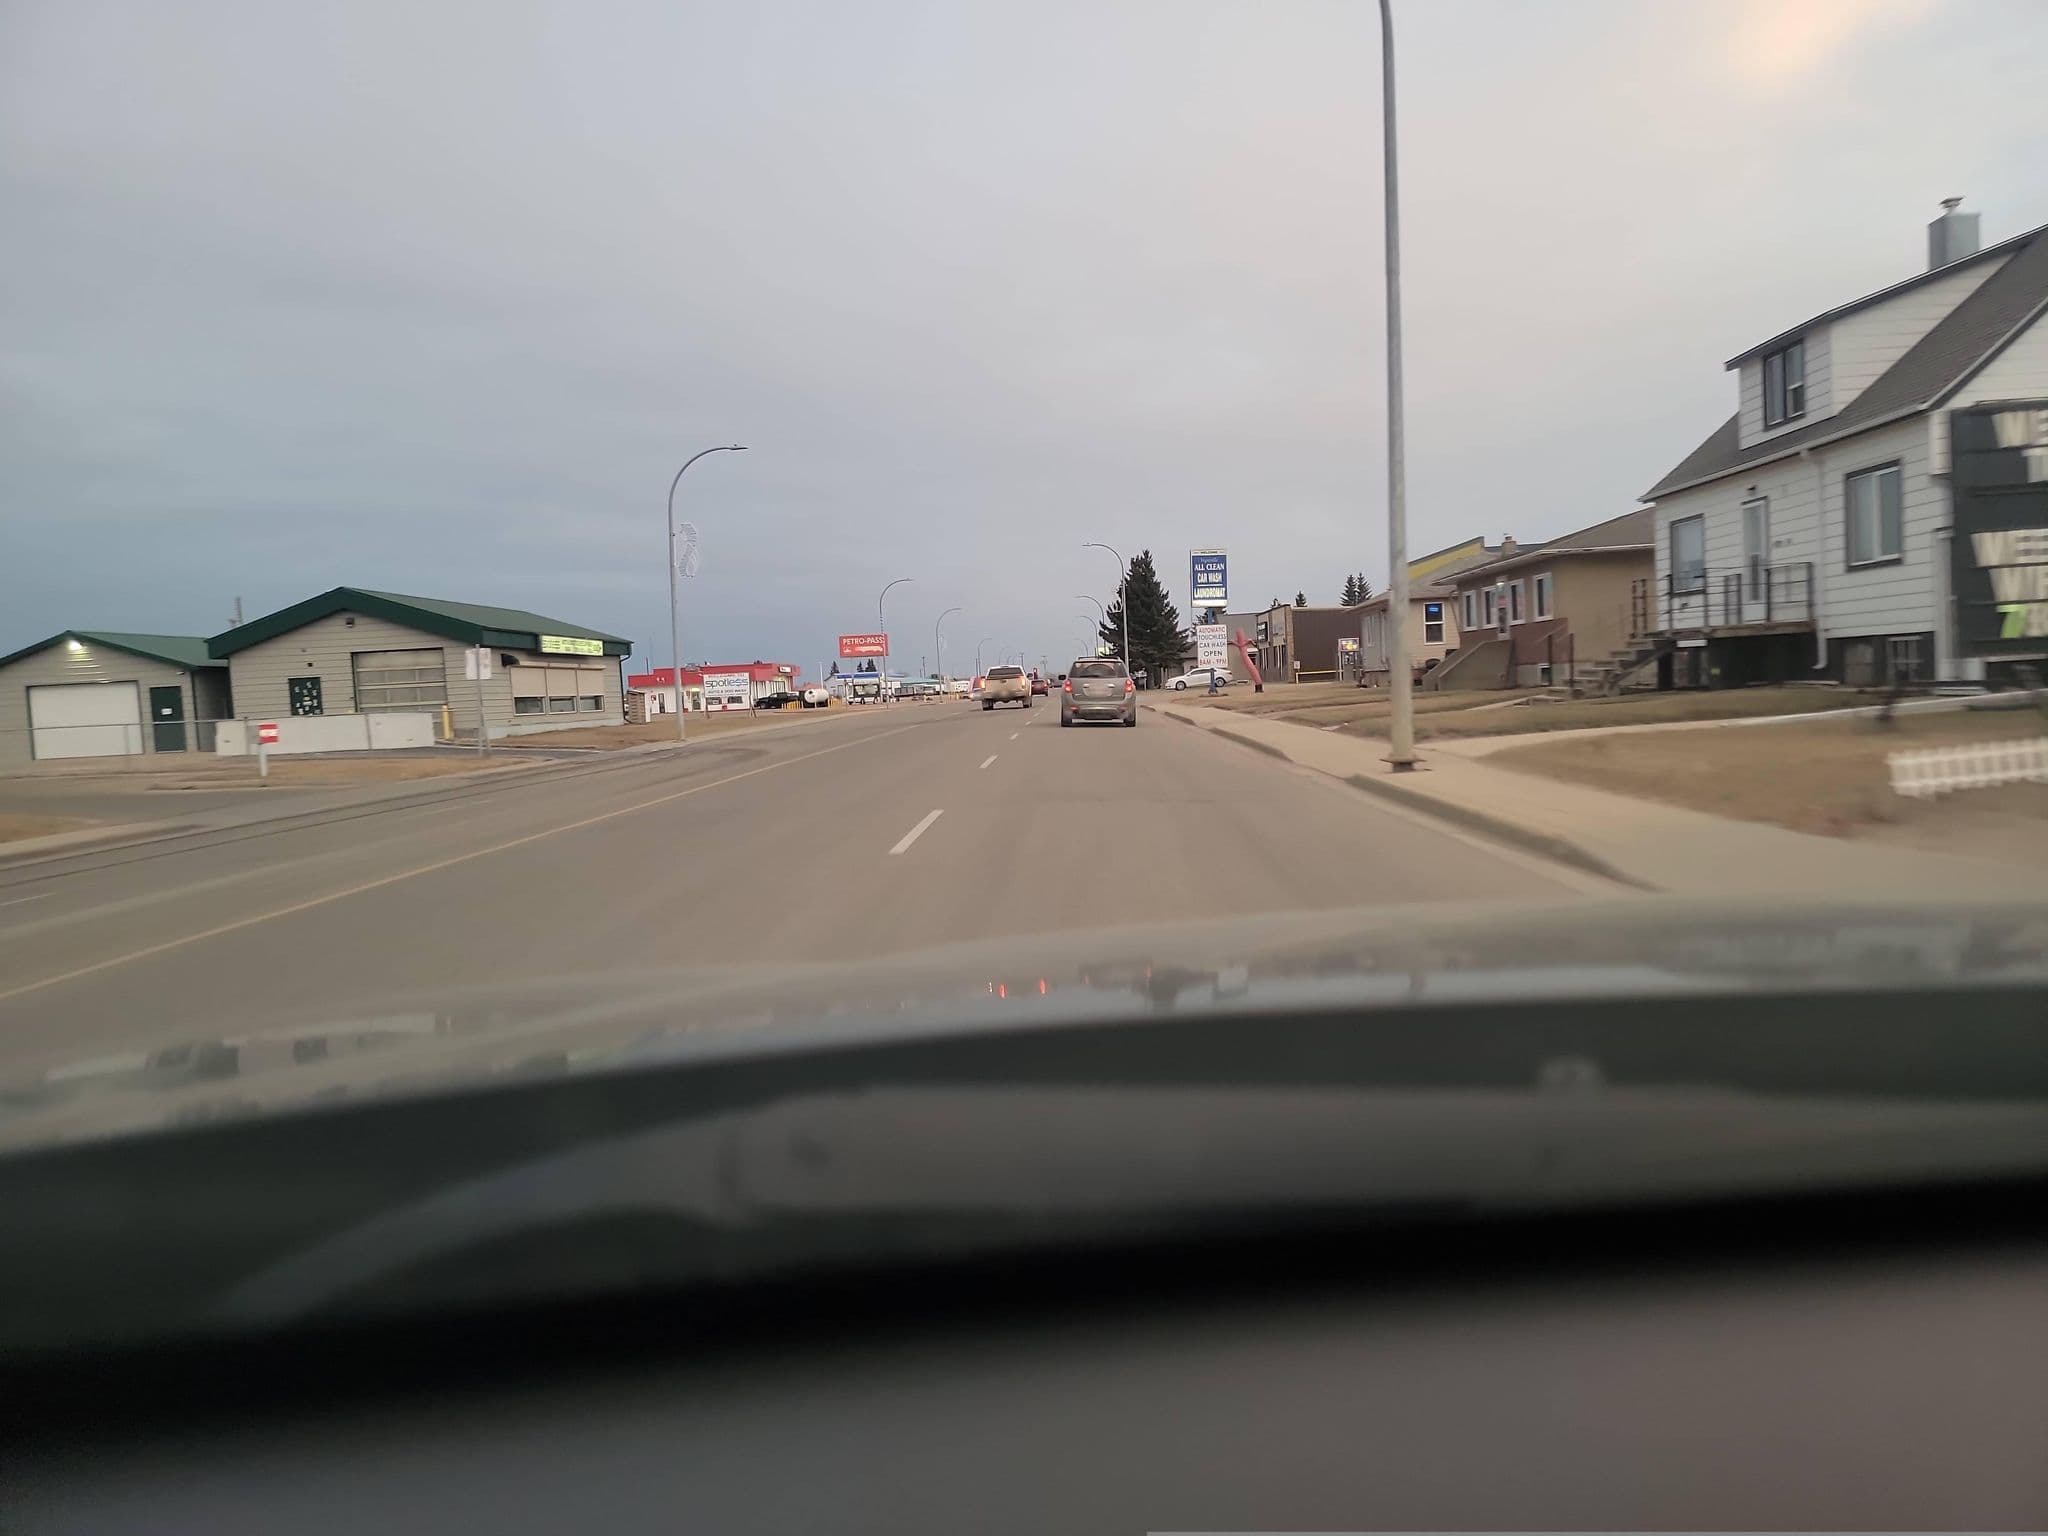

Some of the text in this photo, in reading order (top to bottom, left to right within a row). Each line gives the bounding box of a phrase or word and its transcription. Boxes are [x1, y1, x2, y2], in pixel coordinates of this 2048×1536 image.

[1197, 572, 1222, 583] CAR WASH
[842, 636, 883, 645] PETRO-PASS
[705, 678, 748, 689] spotless
